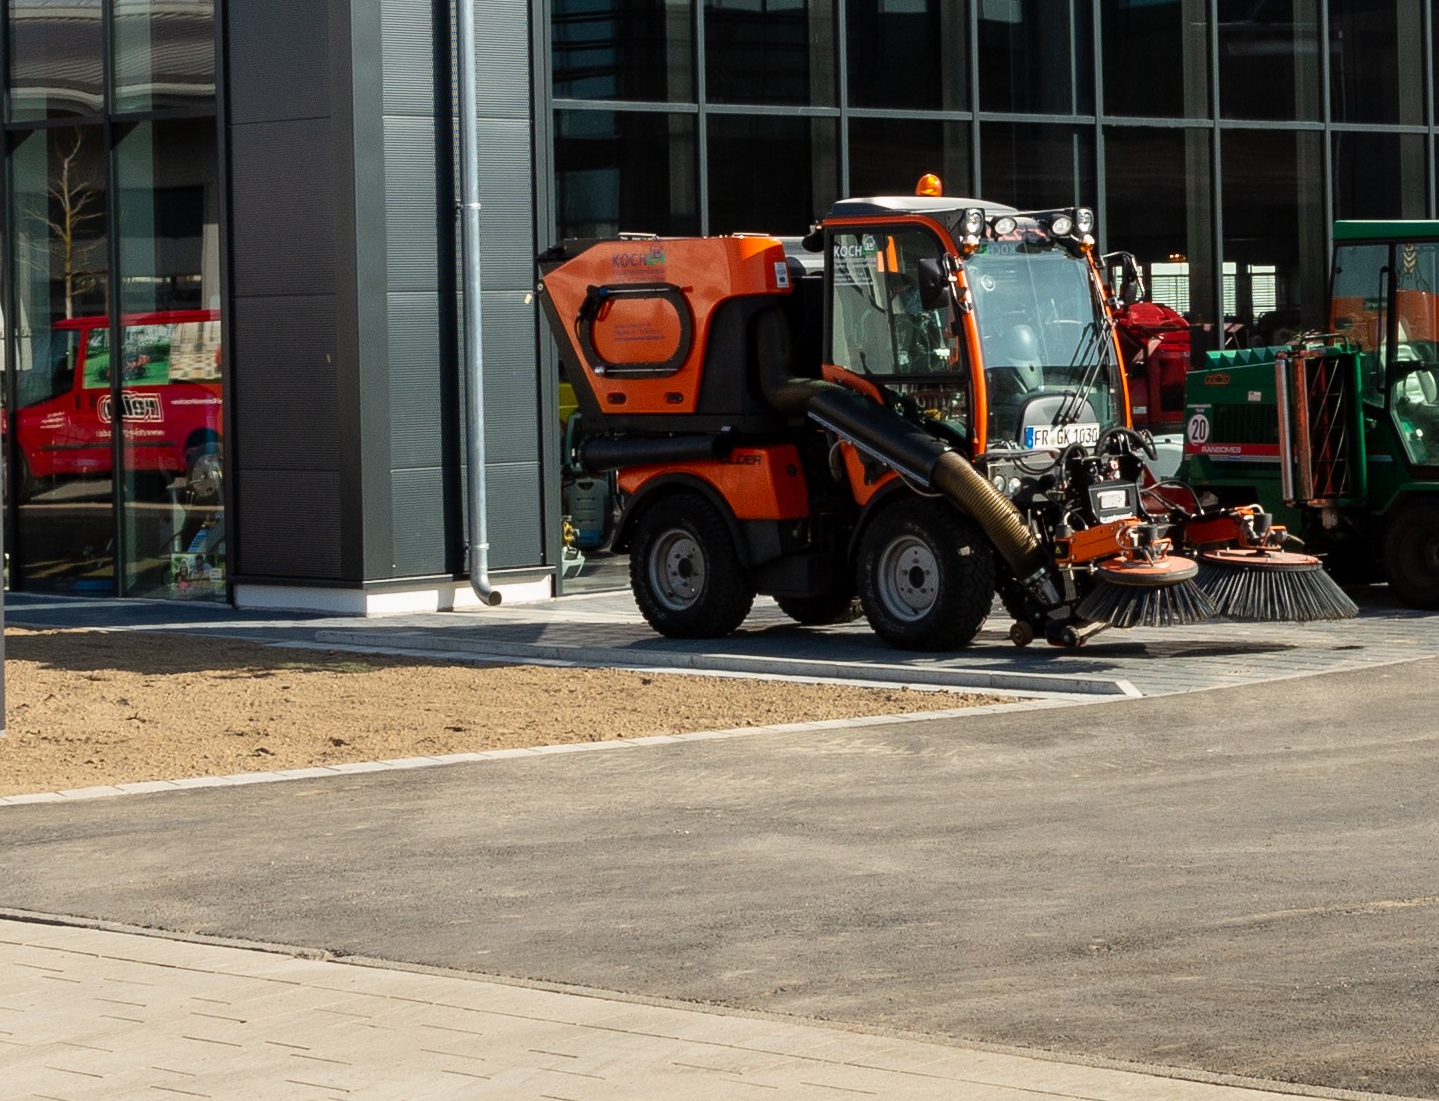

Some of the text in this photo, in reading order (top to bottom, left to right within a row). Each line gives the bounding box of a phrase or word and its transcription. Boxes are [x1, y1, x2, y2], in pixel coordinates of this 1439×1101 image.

[833, 245, 862, 257] KOCH
[1034, 427, 1098, 446] FR GK 1030
[1192, 418, 1206, 440] 20
